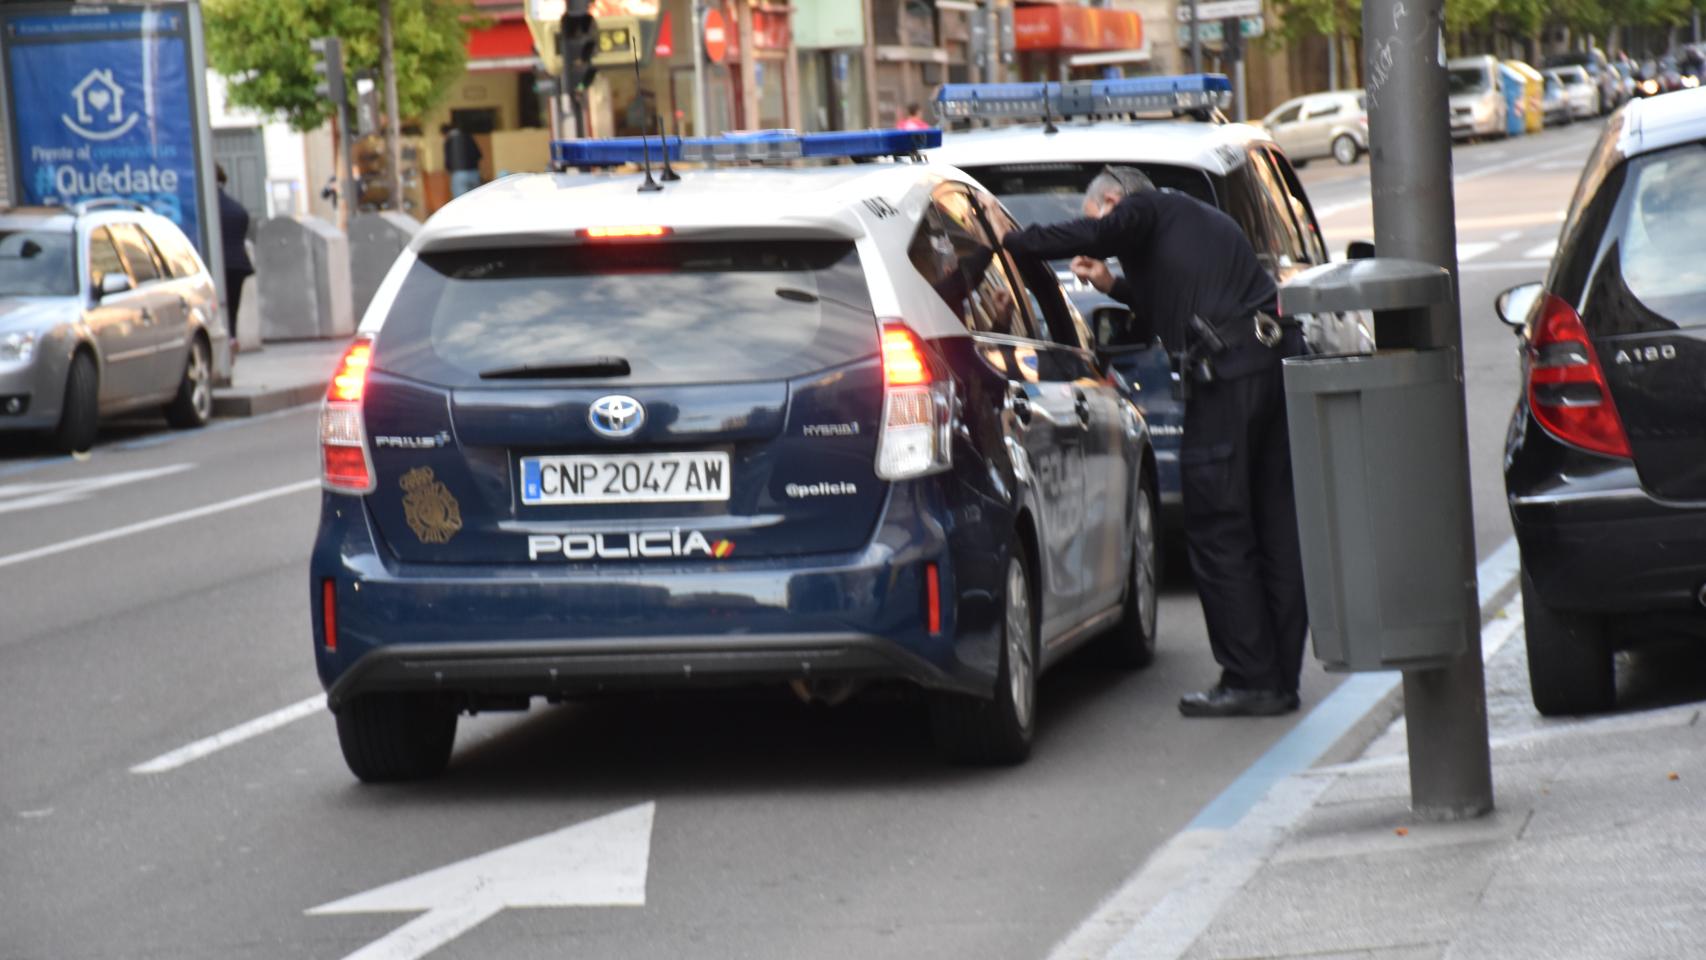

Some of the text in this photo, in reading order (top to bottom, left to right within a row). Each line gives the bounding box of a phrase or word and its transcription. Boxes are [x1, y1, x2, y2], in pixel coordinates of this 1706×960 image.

[1615, 344, 1676, 365] A180
[785, 481, 857, 499] @policia
[528, 526, 712, 561] POLICÍA
